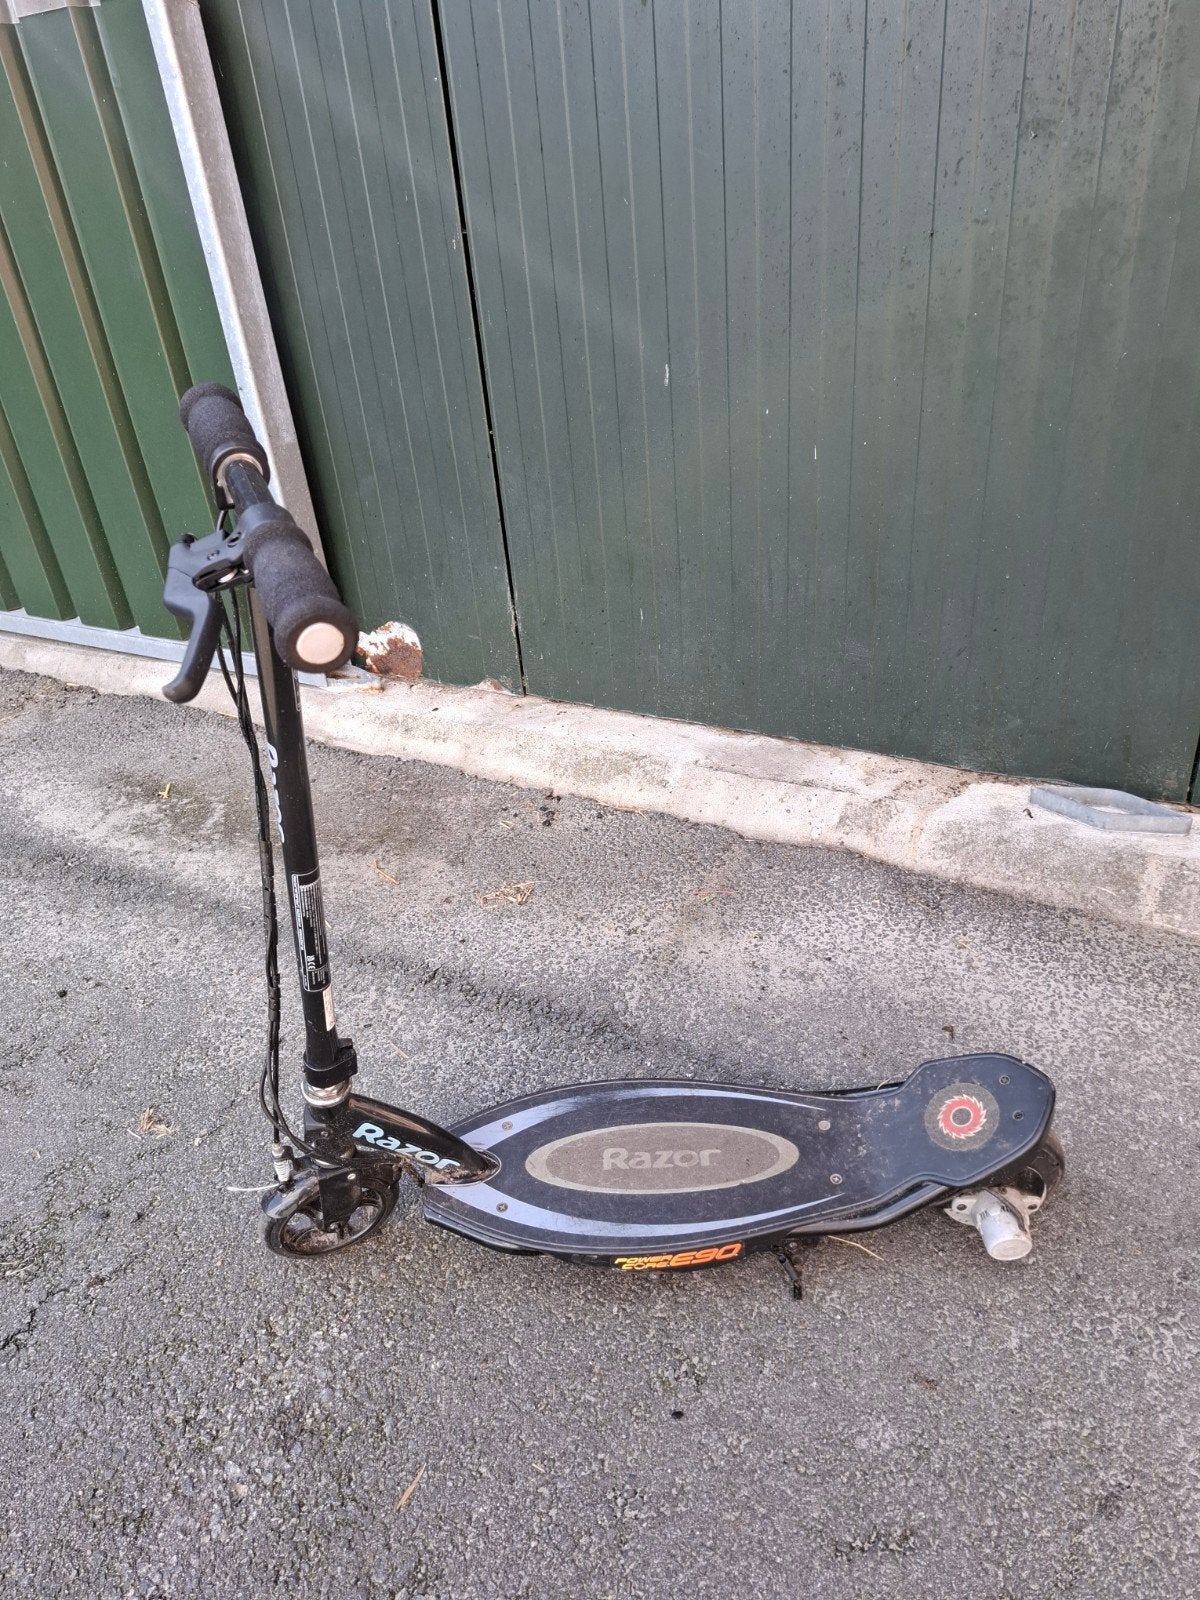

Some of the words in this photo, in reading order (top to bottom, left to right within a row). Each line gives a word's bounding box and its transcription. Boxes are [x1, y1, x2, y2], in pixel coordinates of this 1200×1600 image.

[352, 1122, 461, 1169] Razor
[602, 1147, 722, 1170] Razor
[614, 1254, 673, 1264] POWER
[669, 1243, 742, 1267] E90
